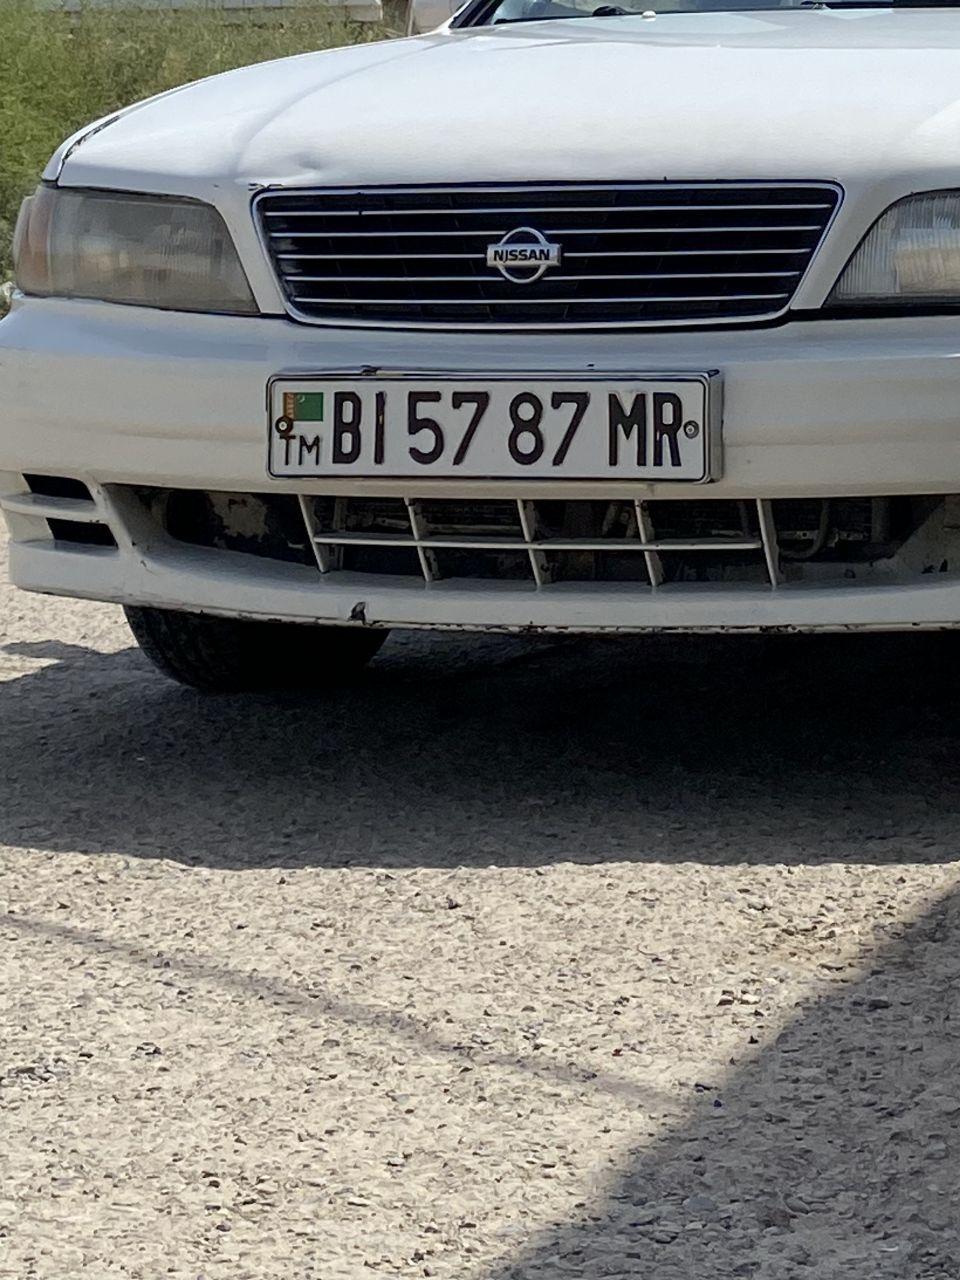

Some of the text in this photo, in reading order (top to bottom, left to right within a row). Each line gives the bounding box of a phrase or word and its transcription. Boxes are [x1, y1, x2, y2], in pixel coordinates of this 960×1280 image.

[493, 248, 550, 263] NISSAN
[332, 391, 386, 465] BI
[608, 392, 683, 467] MR
[279, 434, 321, 466] TM
